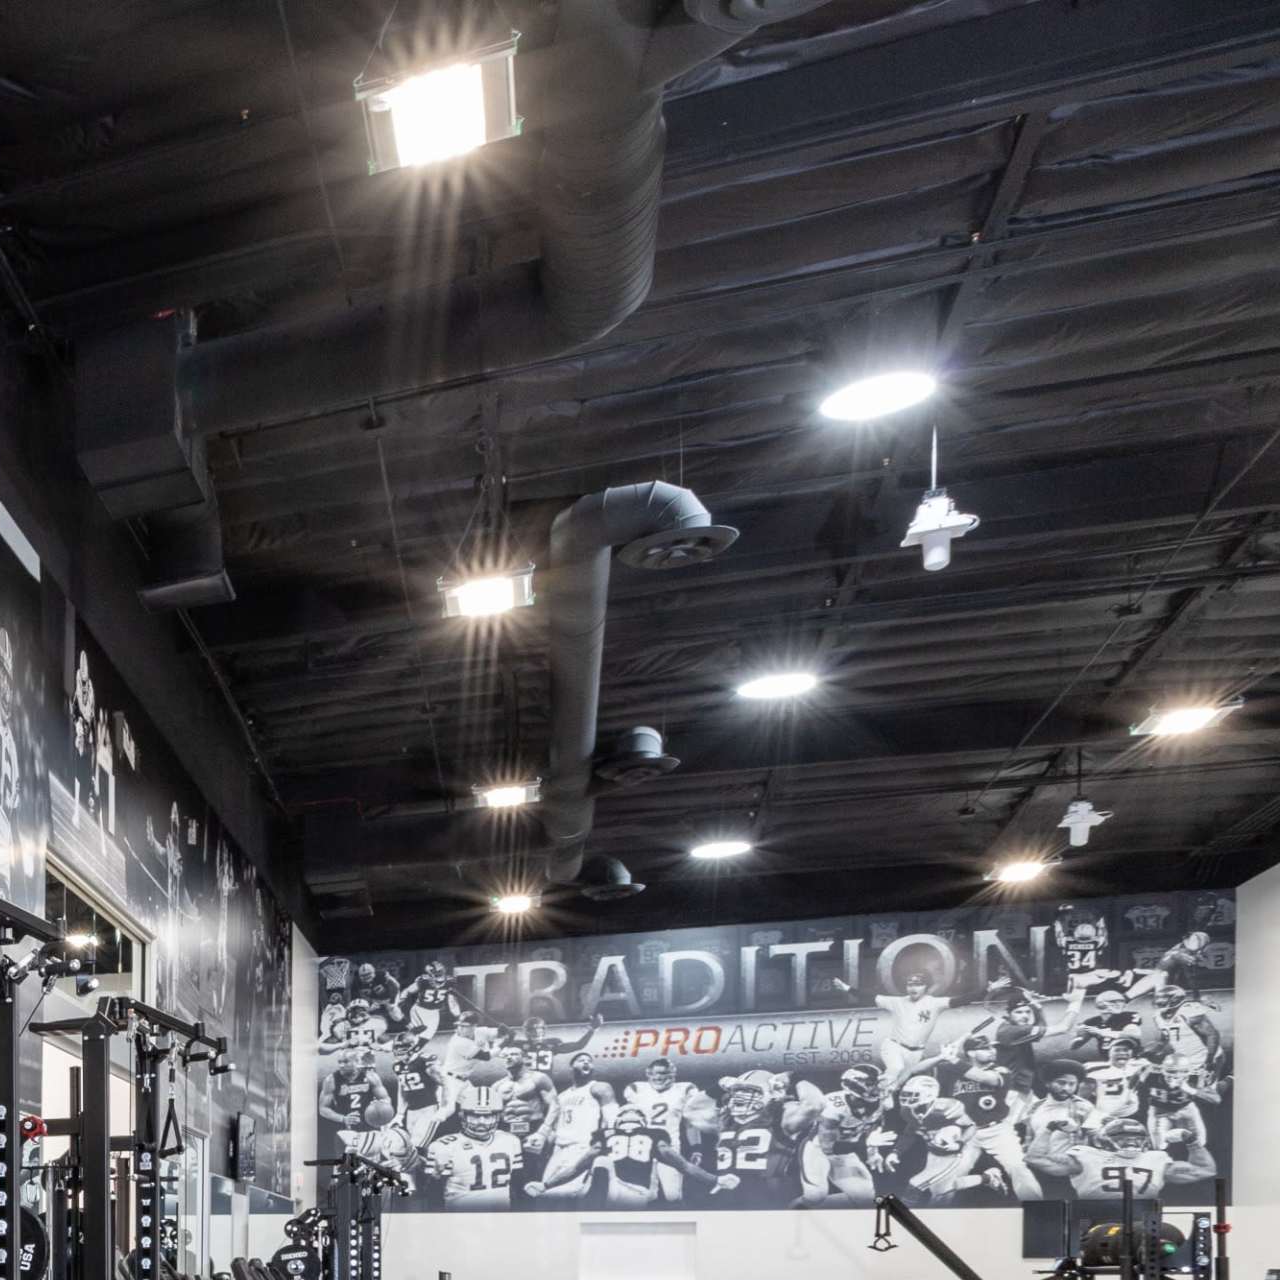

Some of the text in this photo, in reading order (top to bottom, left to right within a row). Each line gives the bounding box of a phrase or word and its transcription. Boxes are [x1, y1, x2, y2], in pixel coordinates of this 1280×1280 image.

[453, 925, 1050, 1018] TRADITION
[1067, 952, 1097, 969] 34
[424, 990, 446, 1004] 55
[630, 1017, 878, 1057] PROACTIVE
[830, 1049, 873, 1064] 2006
[351, 1094, 361, 1109] 2
[651, 1103, 668, 1126] 2
[470, 1152, 511, 1191] 12
[1101, 1166, 1154, 1194] 97
[20, 1243, 35, 1271] USA
